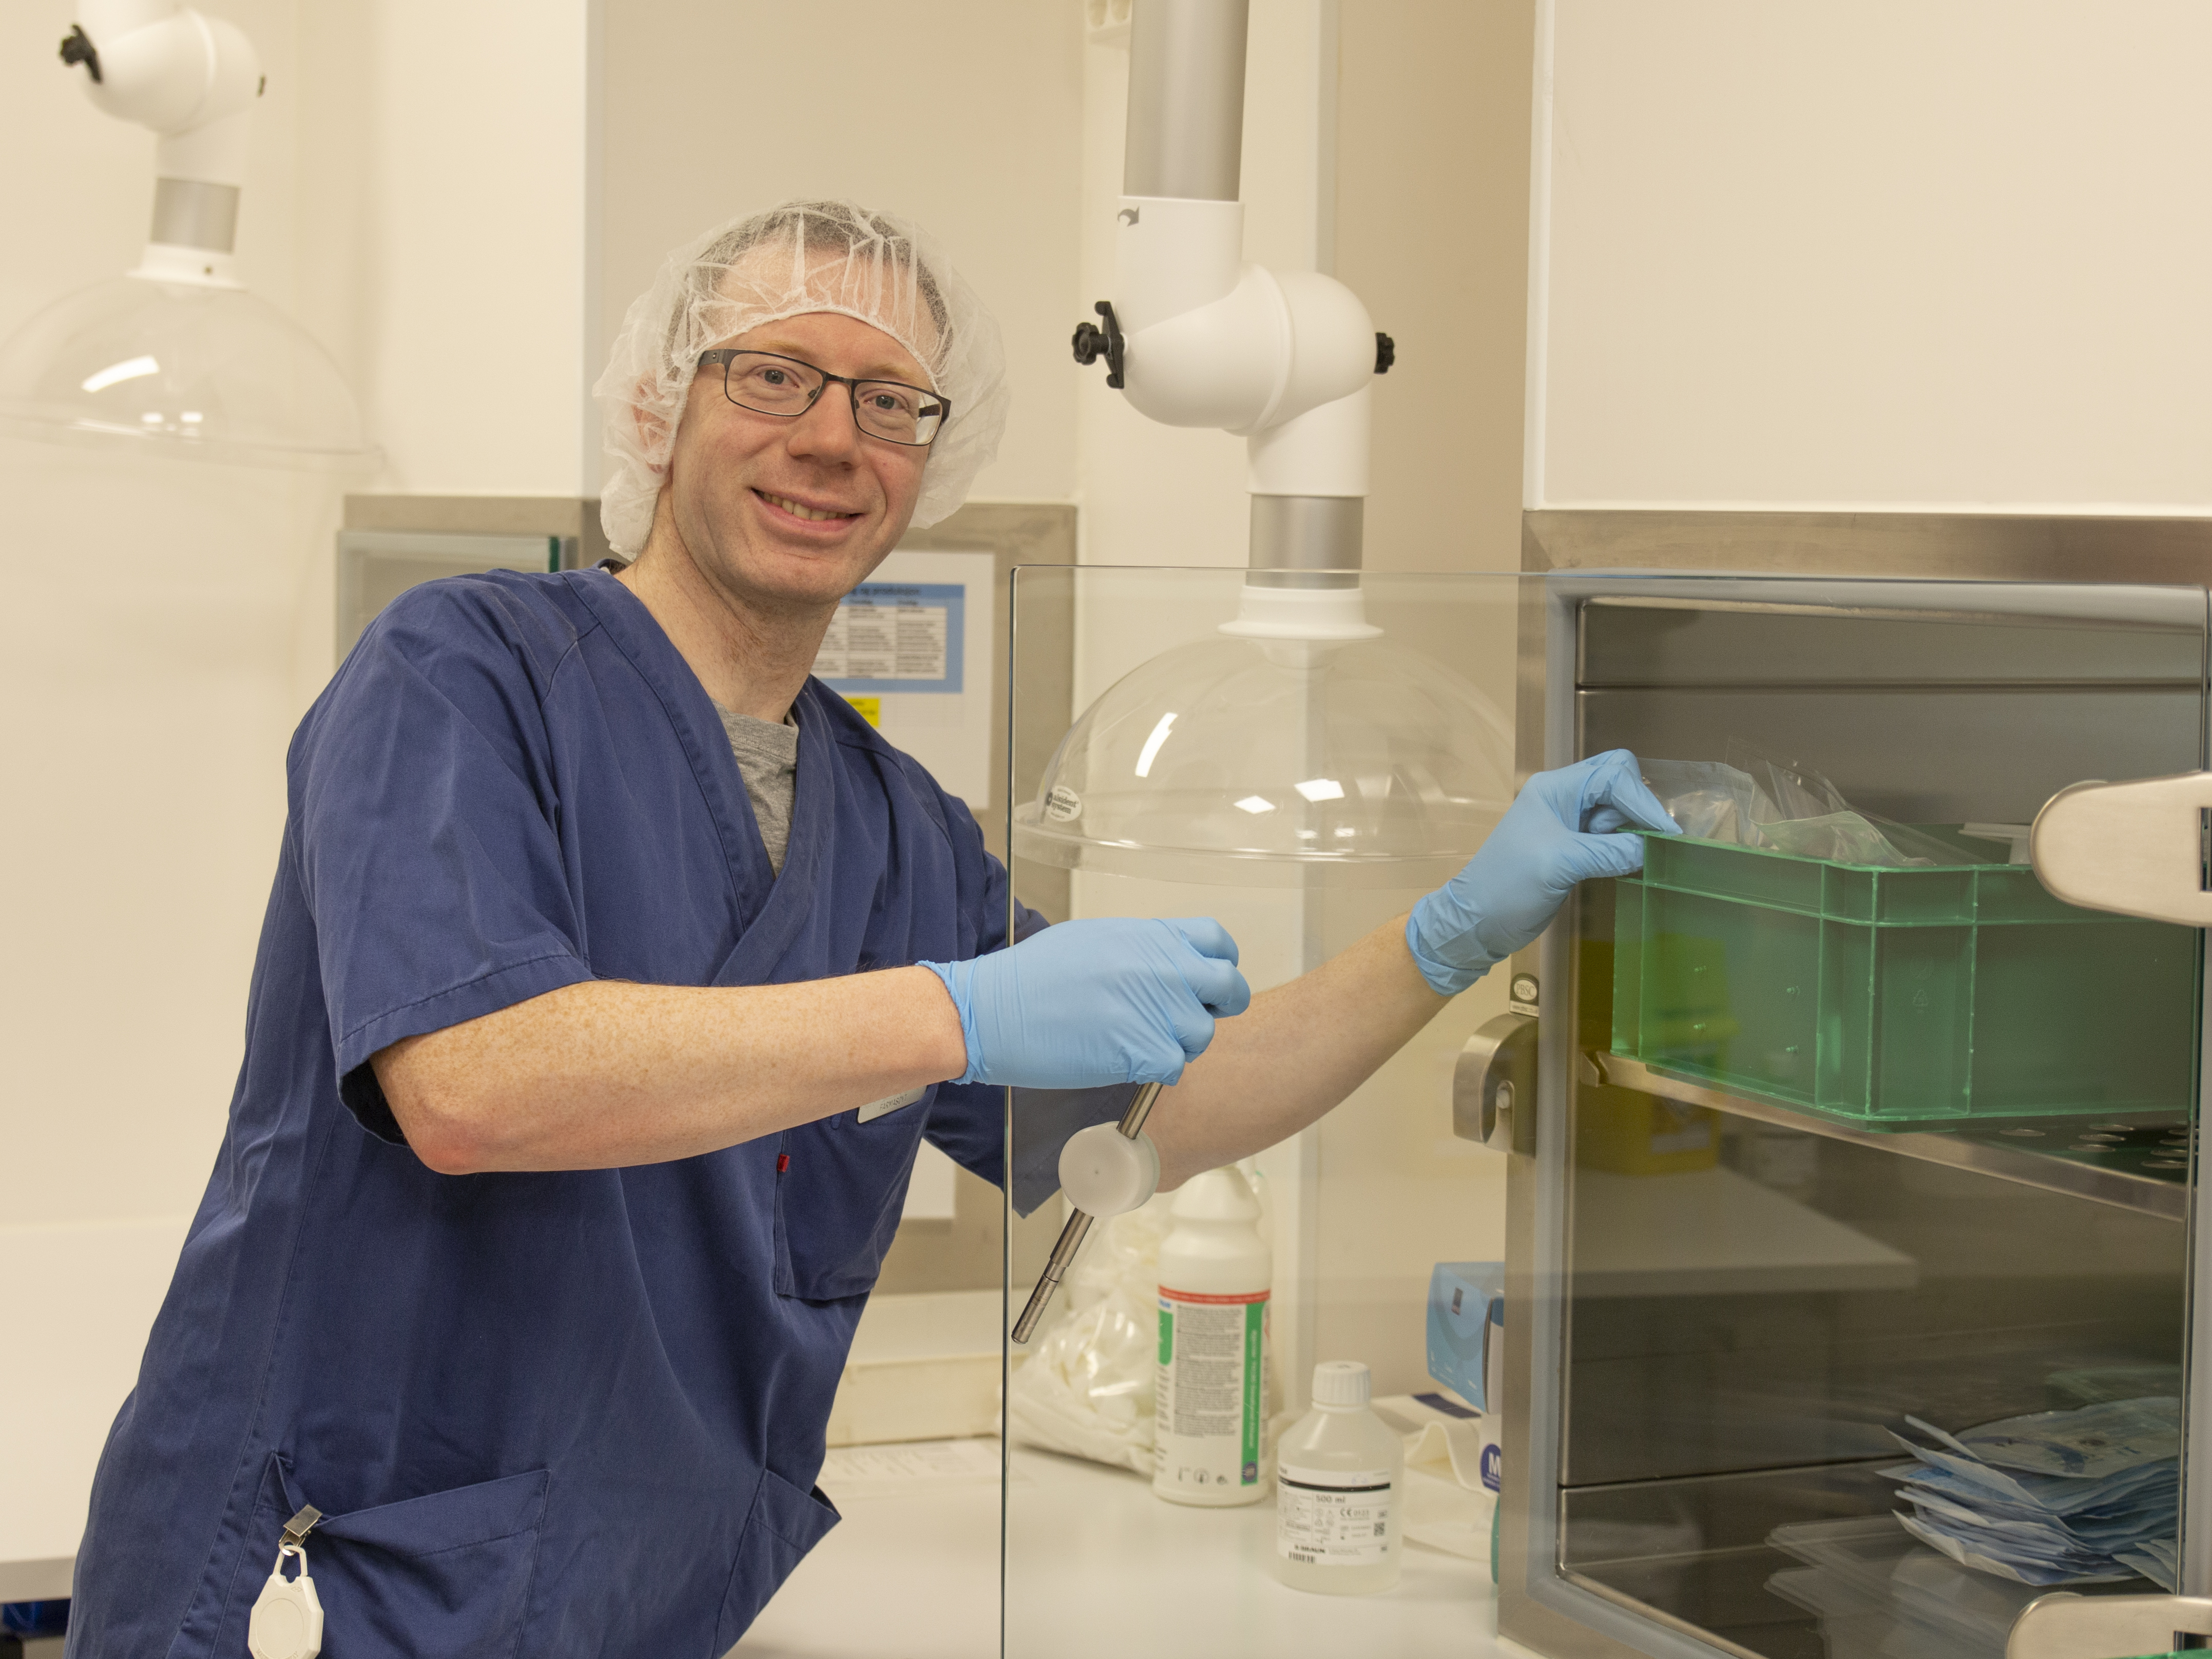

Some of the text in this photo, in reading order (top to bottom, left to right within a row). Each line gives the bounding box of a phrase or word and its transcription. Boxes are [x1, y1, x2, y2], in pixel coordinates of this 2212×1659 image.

[1053, 794, 1076, 808] alsident
[1051, 802, 1071, 815] system
[1516, 982, 1535, 997] PBSC
[1316, 1494, 1345, 1503] 500 ml
